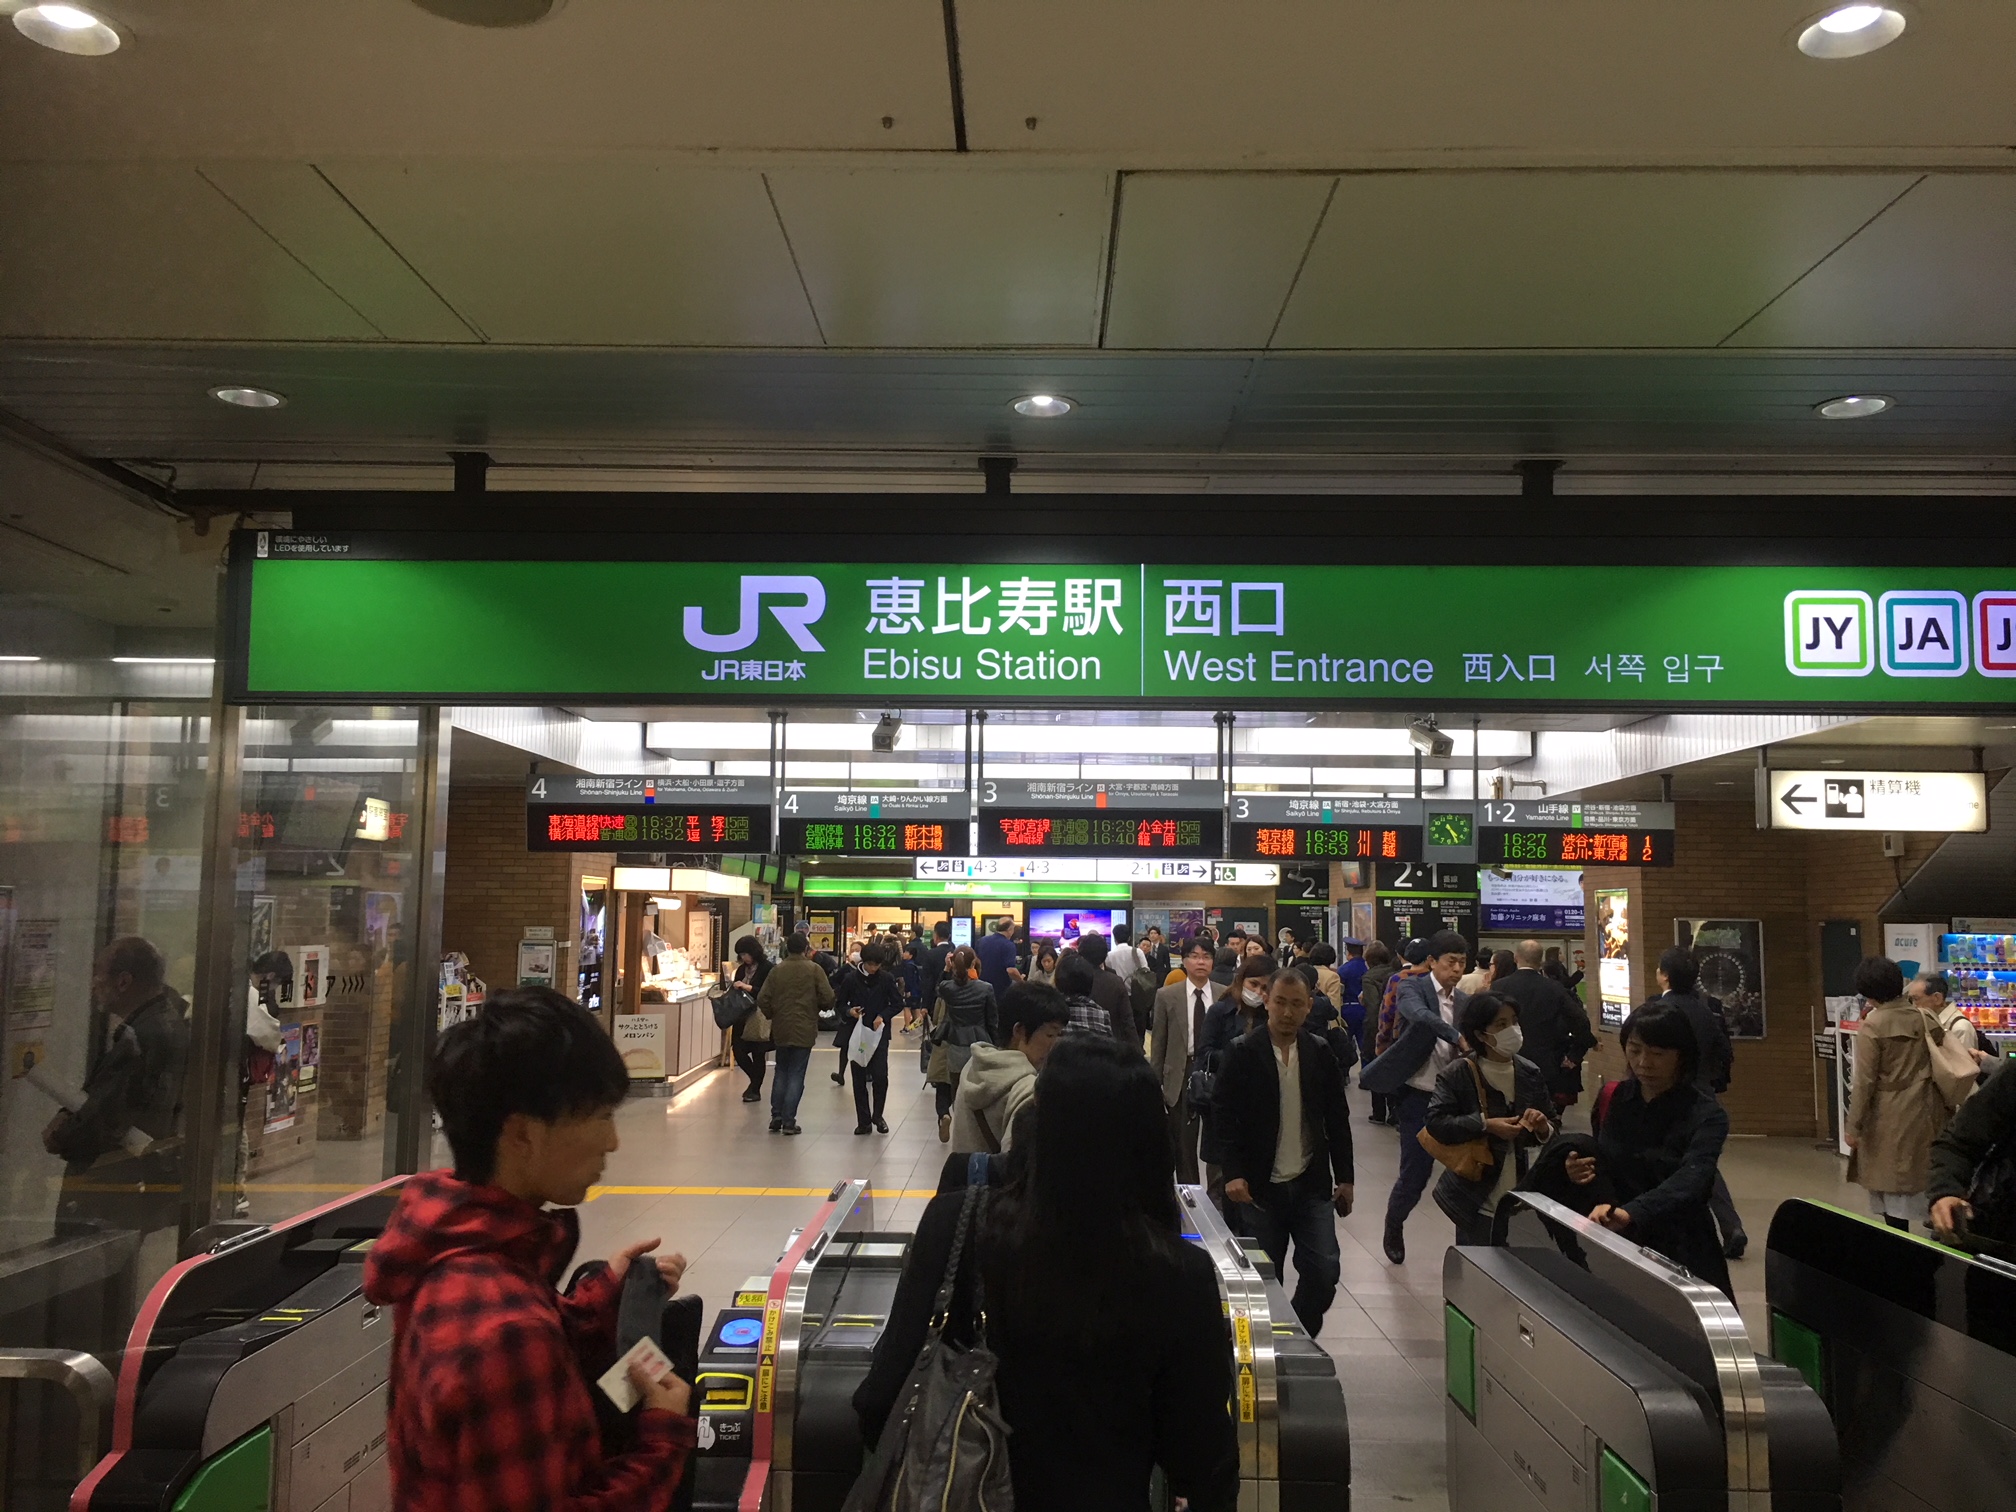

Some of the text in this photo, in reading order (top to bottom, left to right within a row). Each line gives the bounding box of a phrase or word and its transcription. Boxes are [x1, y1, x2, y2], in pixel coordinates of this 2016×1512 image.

[274, 544, 350, 552] LEDを使用しています
[865, 576, 1124, 636] 恵比寿駅
[1163, 579, 1285, 636] 西口
[683, 575, 826, 653] JR
[1805, 617, 1853, 650] JY
[1898, 617, 1950, 651] JA
[702, 660, 806, 681] JR東日本
[864, 648, 1101, 681] Ebisu Station
[1163, 650, 1434, 683] West Entrance
[1462, 652, 1556, 683] 西入口
[1584, 652, 1725, 684] 서쪽 입구
[531, 778, 547, 799] 4
[575, 778, 643, 789] 湘南新宿ライン
[1026, 782, 1094, 793] 湘南新宿ライン
[1870, 779, 1921, 796] 精算機
[837, 794, 868, 805] 埼京線
[983, 782, 998, 803] 3
[784, 794, 799, 814] 4
[1236, 799, 1249, 818] 3
[1289, 800, 1320, 810] 埼京線
[1538, 804, 1569, 814] 山手線
[642, 815, 684, 828] 16:37
[1093, 819, 1135, 832] 16:29
[642, 828, 684, 841] 16:52
[854, 824, 896, 837] 16:32
[904, 824, 943, 837] 新木場
[1006, 831, 1044, 845] 高崎線
[1093, 832, 1135, 845] 16:40
[1256, 828, 1295, 842] 埼京線
[1305, 829, 1349, 842] 16:36
[854, 837, 896, 850] 16:44
[904, 837, 943, 851] 新木場
[1503, 833, 1547, 846] 16:27
[1644, 835, 1651, 847] 1
[1256, 842, 1295, 855] 埼京線
[1305, 842, 1349, 855] 16:53
[1503, 845, 1547, 858] 16:26
[1642, 848, 1652, 861] 2
[1302, 877, 1316, 898] 2
[1894, 937, 1919, 948] acure
[739, 1293, 767, 1303] 残額
[764, 1309, 777, 1352] かけこみ禁止
[719, 1422, 741, 1433] きっぷ
